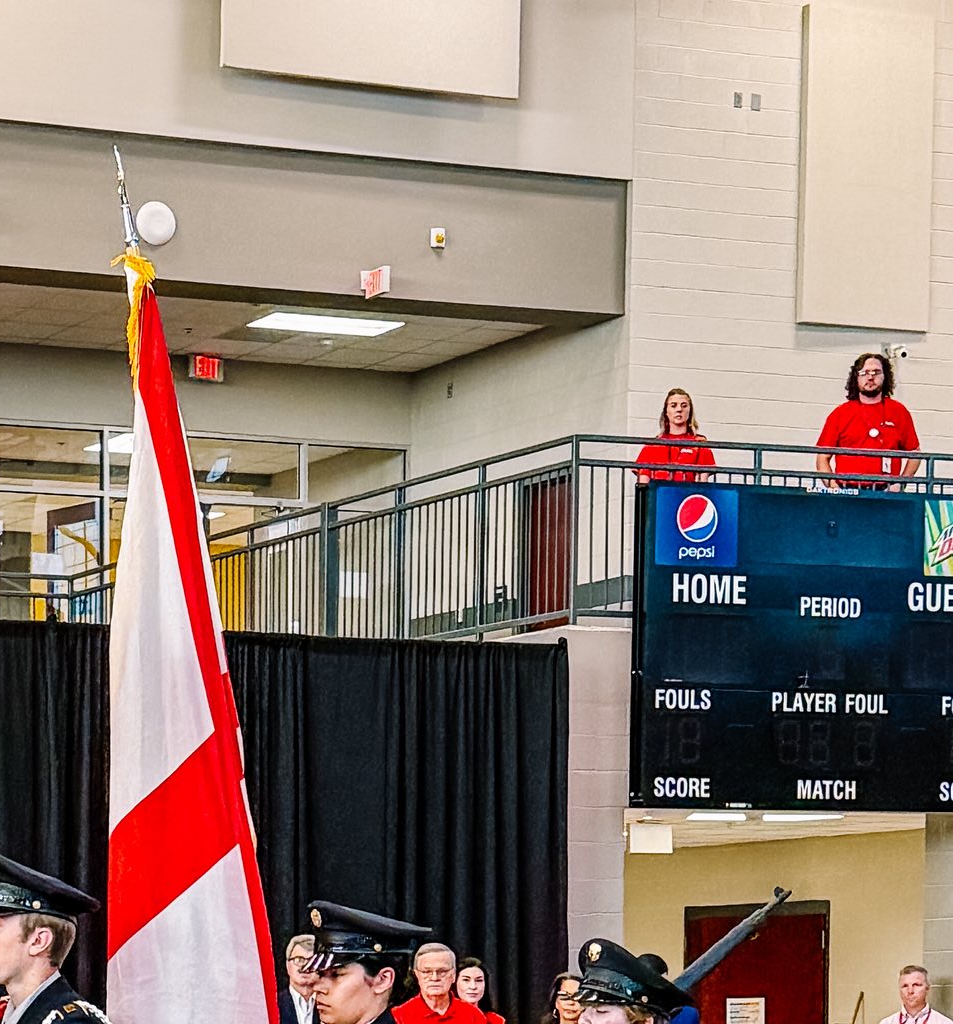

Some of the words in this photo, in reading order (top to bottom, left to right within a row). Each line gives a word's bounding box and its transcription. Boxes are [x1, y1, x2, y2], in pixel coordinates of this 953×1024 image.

[678, 546, 715, 560] pepsi
[672, 573, 747, 605] HOME
[800, 596, 861, 618] PERIOD
[654, 688, 711, 710] FOULS
[771, 692, 837, 714] PLAYER
[845, 693, 888, 715] FOUL
[654, 777, 711, 799] SCORE
[797, 779, 857, 801] MATCH
